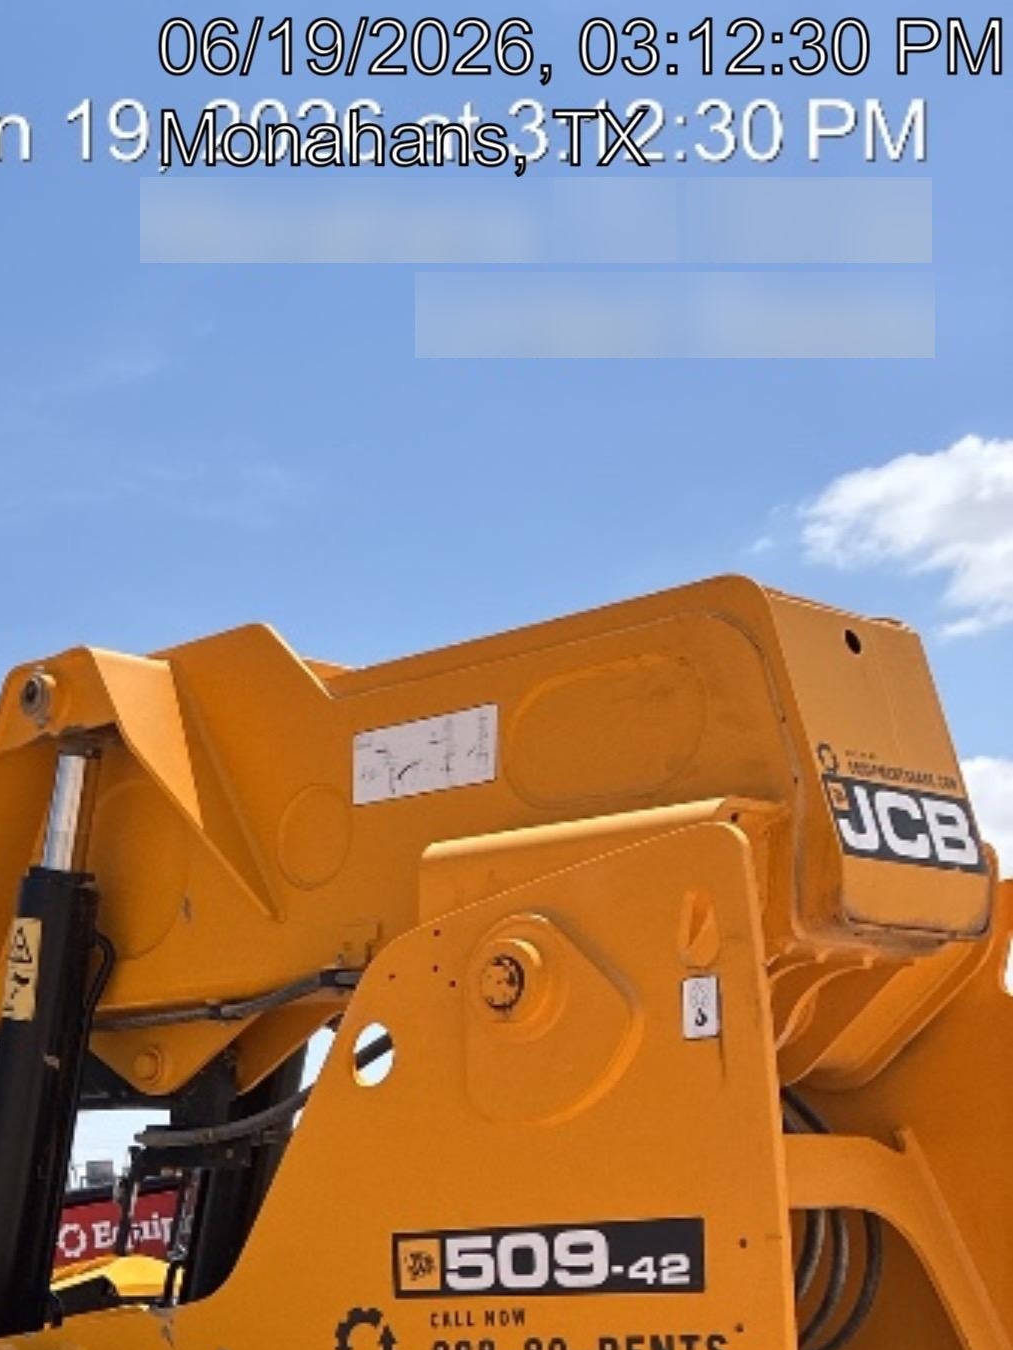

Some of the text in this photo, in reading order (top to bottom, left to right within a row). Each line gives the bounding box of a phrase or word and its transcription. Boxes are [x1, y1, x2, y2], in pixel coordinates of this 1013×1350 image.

[837, 785, 980, 866] JCB
[445, 1228, 691, 1291] 509-42
[430, 1308, 526, 1328] CALL NOW
